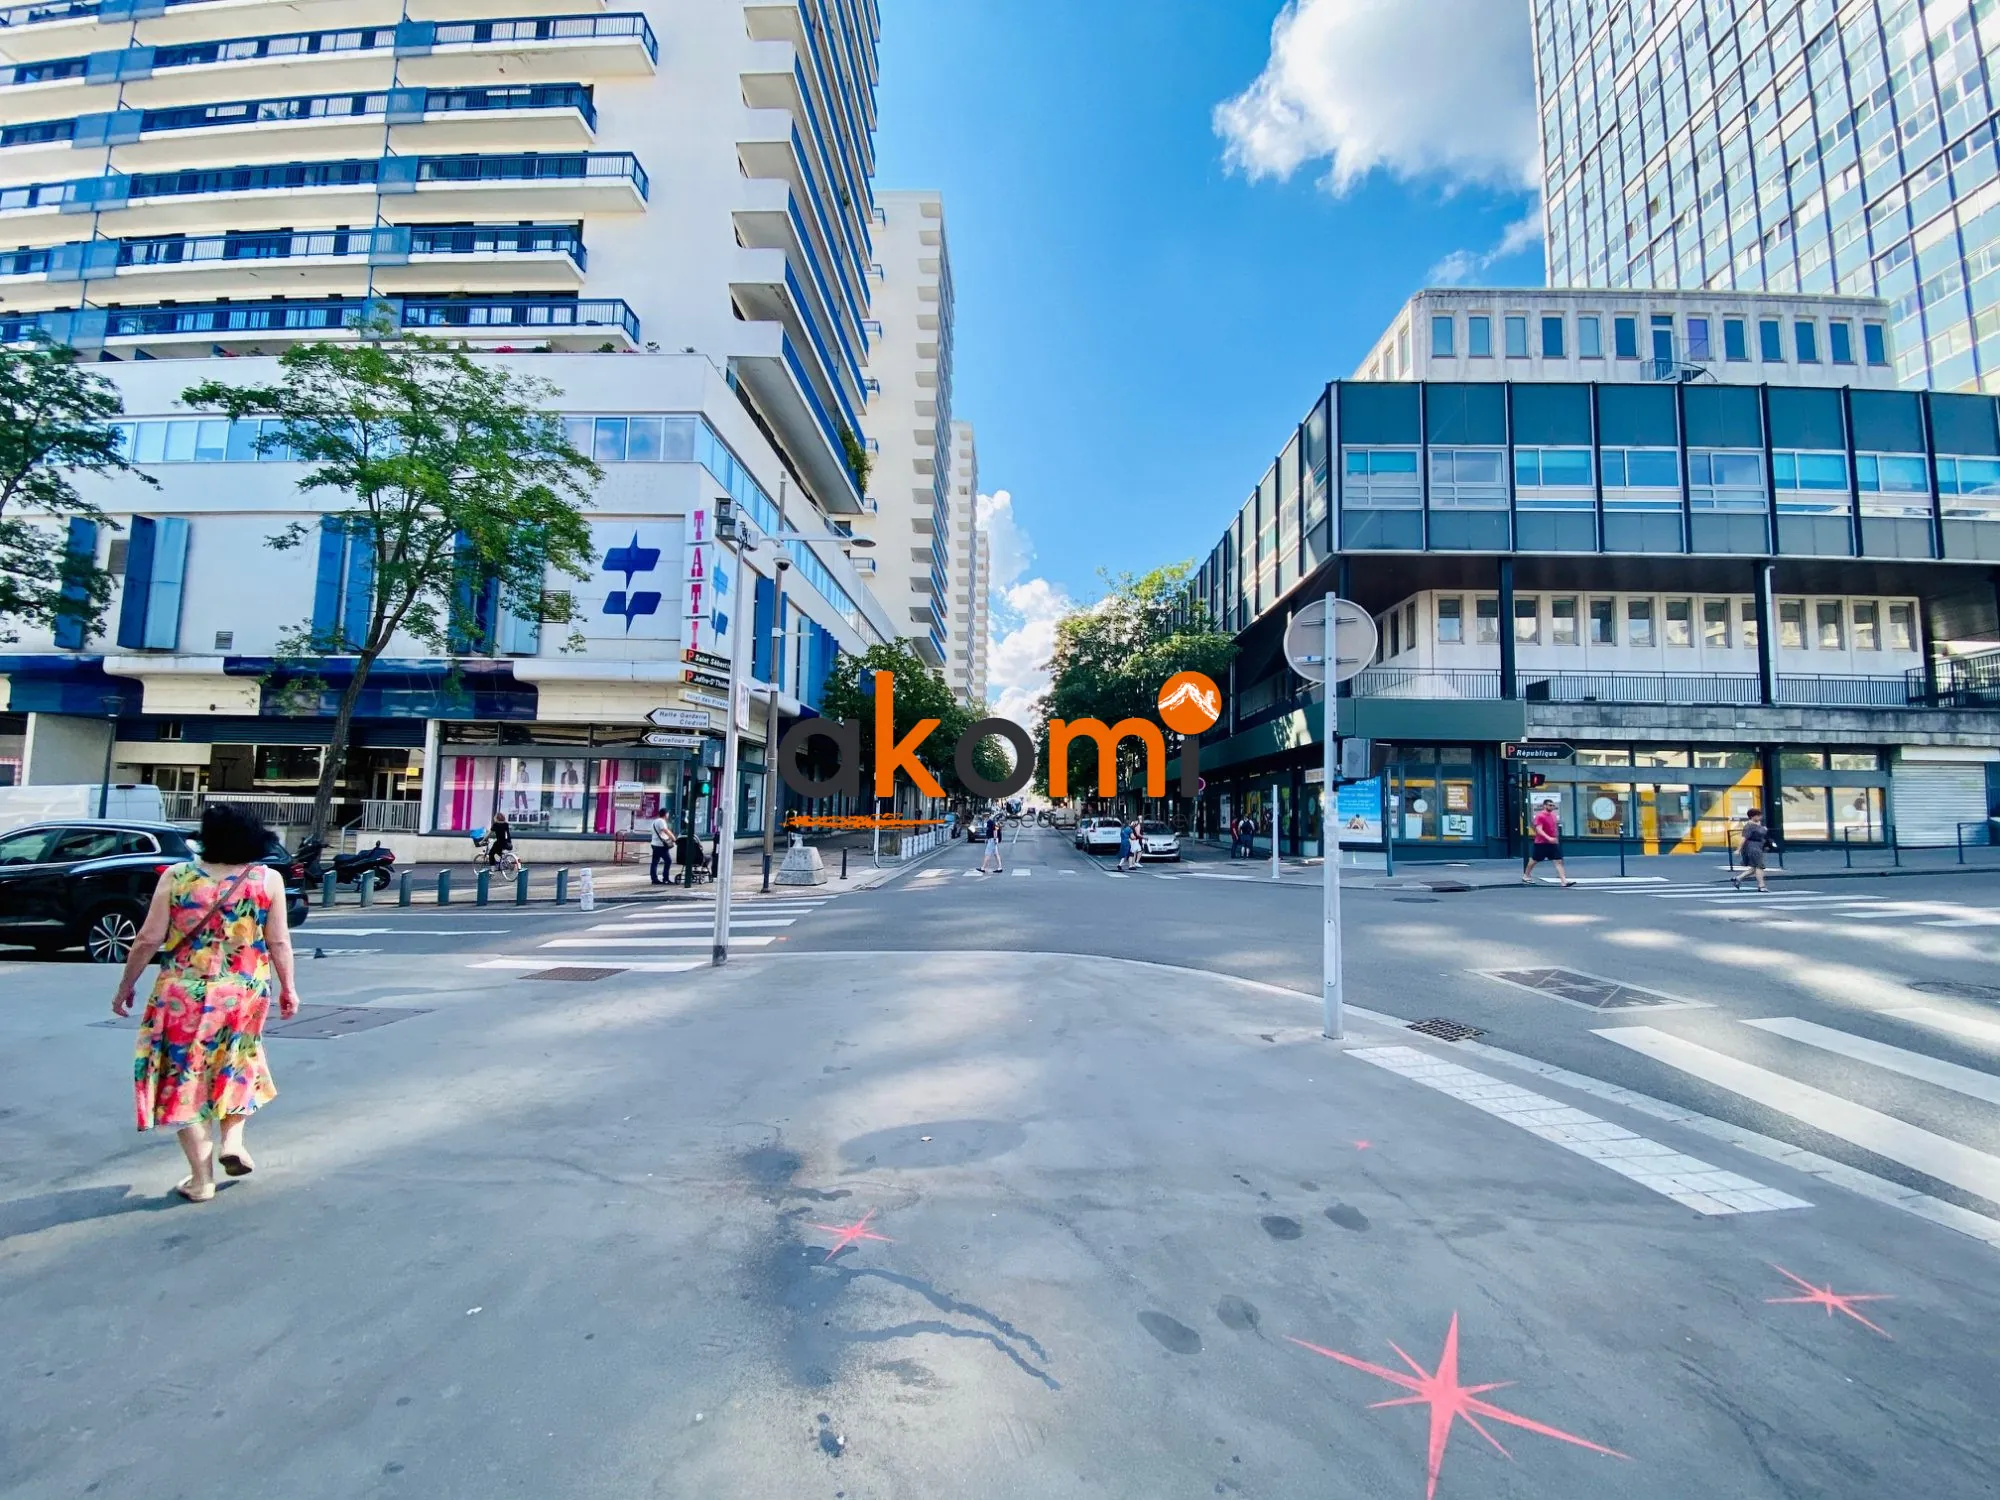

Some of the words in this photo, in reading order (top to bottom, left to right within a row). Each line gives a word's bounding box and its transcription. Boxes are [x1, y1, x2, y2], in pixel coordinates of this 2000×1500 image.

[689, 510, 704, 650] TATI
[688, 651, 694, 661] P
[695, 655, 709, 663] Saint
[687, 671, 693, 682] P
[1508, 746, 1515, 756] P
[1516, 749, 1558, 757] République
